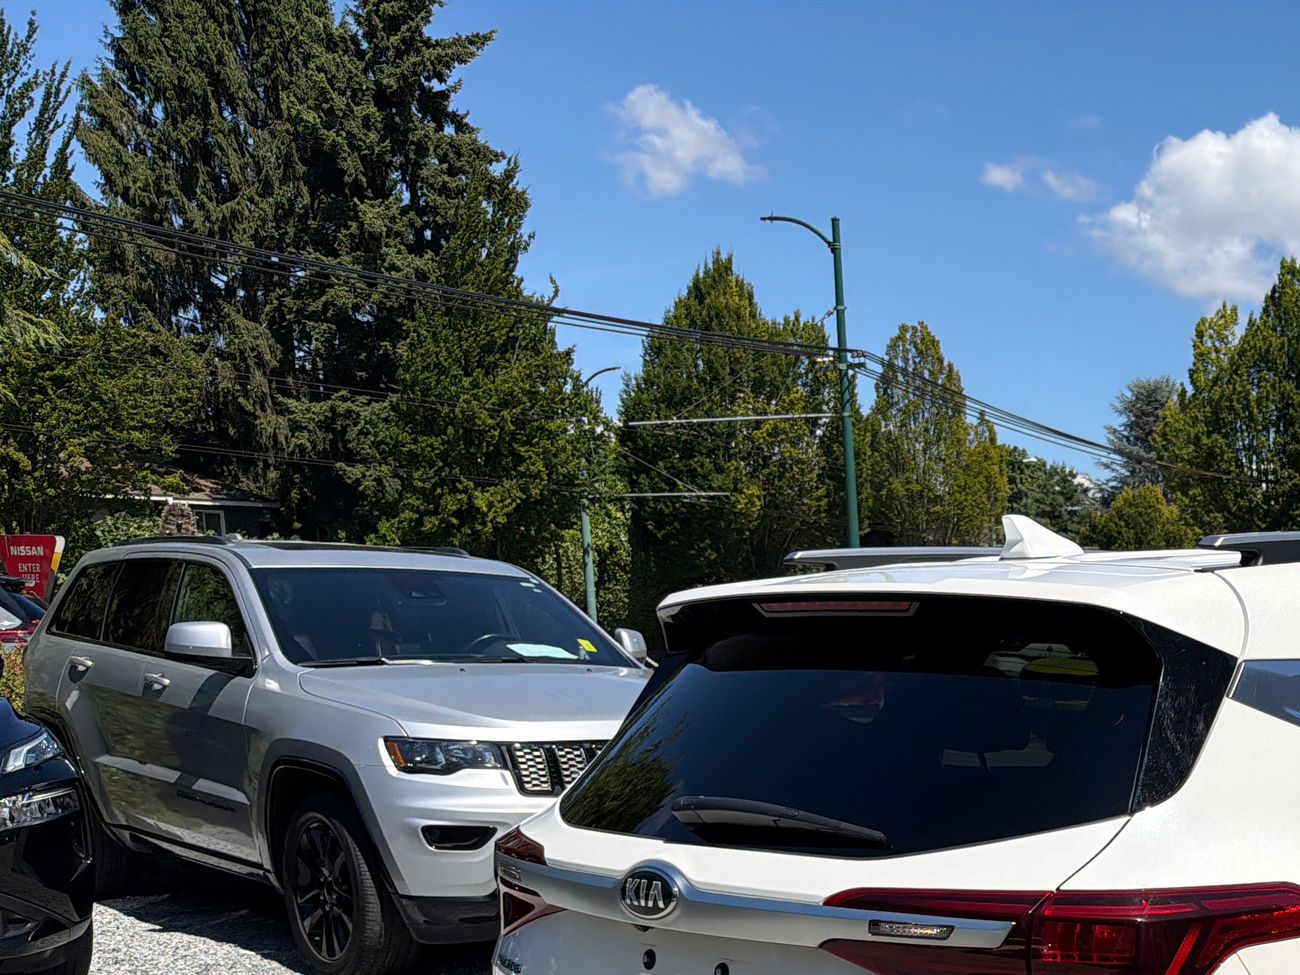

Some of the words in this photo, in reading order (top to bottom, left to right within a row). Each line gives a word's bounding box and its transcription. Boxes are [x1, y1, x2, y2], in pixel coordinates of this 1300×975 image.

[10, 545, 44, 556] NISSAN
[18, 563, 41, 573] ENTER
[626, 878, 666, 909] KIA
